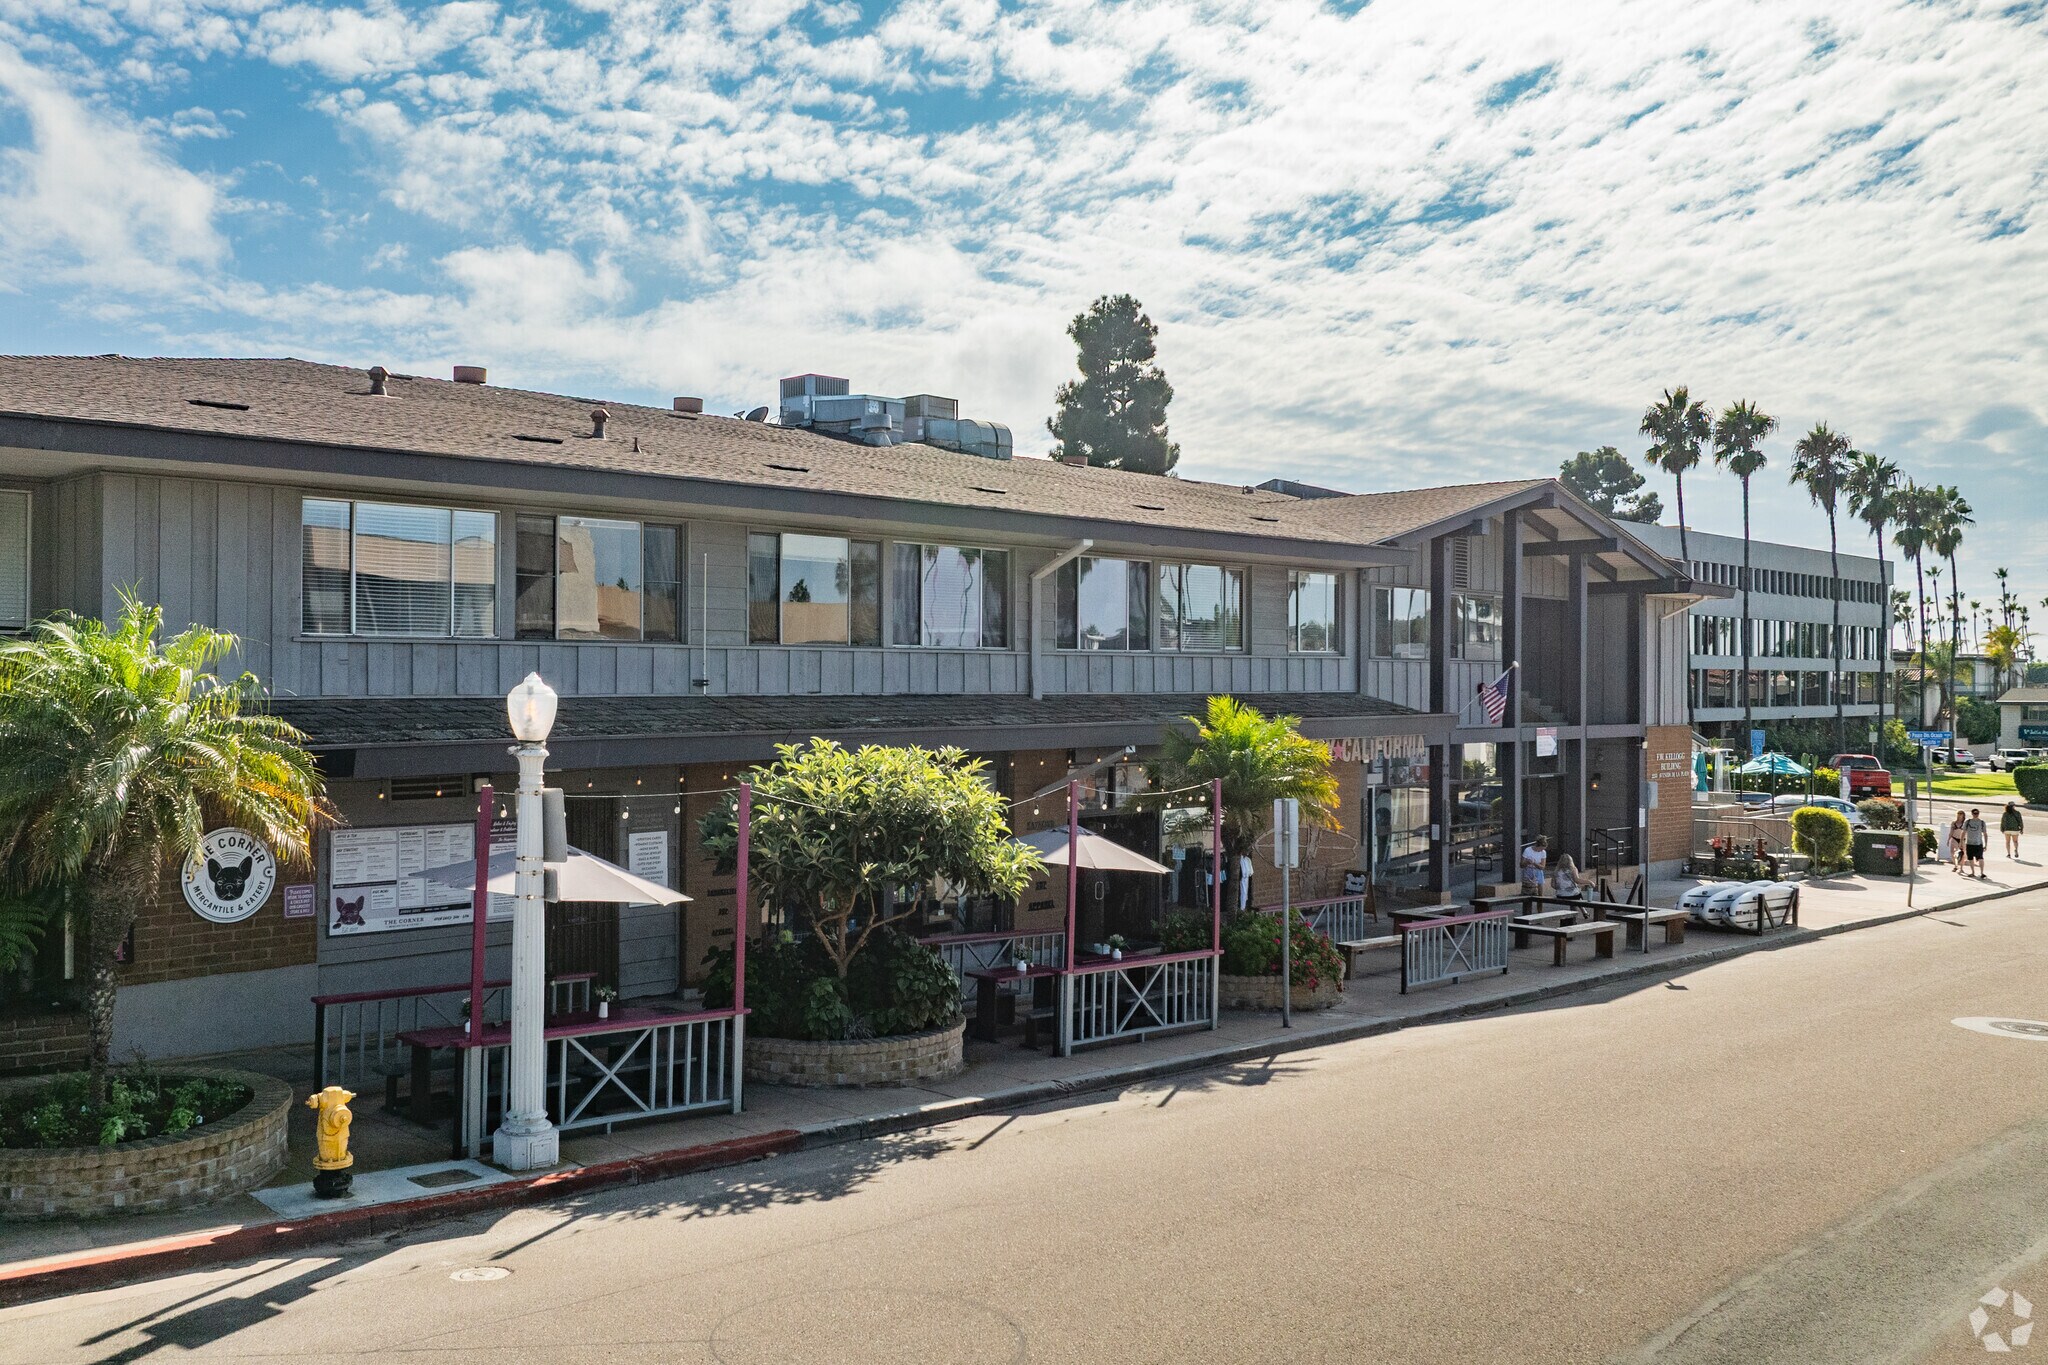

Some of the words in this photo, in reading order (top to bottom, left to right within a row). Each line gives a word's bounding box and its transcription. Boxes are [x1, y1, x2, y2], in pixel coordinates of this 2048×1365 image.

[1342, 735, 1425, 762] CALIFORNIA
[218, 836, 266, 864] CORNER
[193, 885, 235, 913] MERCANTILE
[238, 903, 244, 911] &
[245, 881, 266, 907] EATERY
